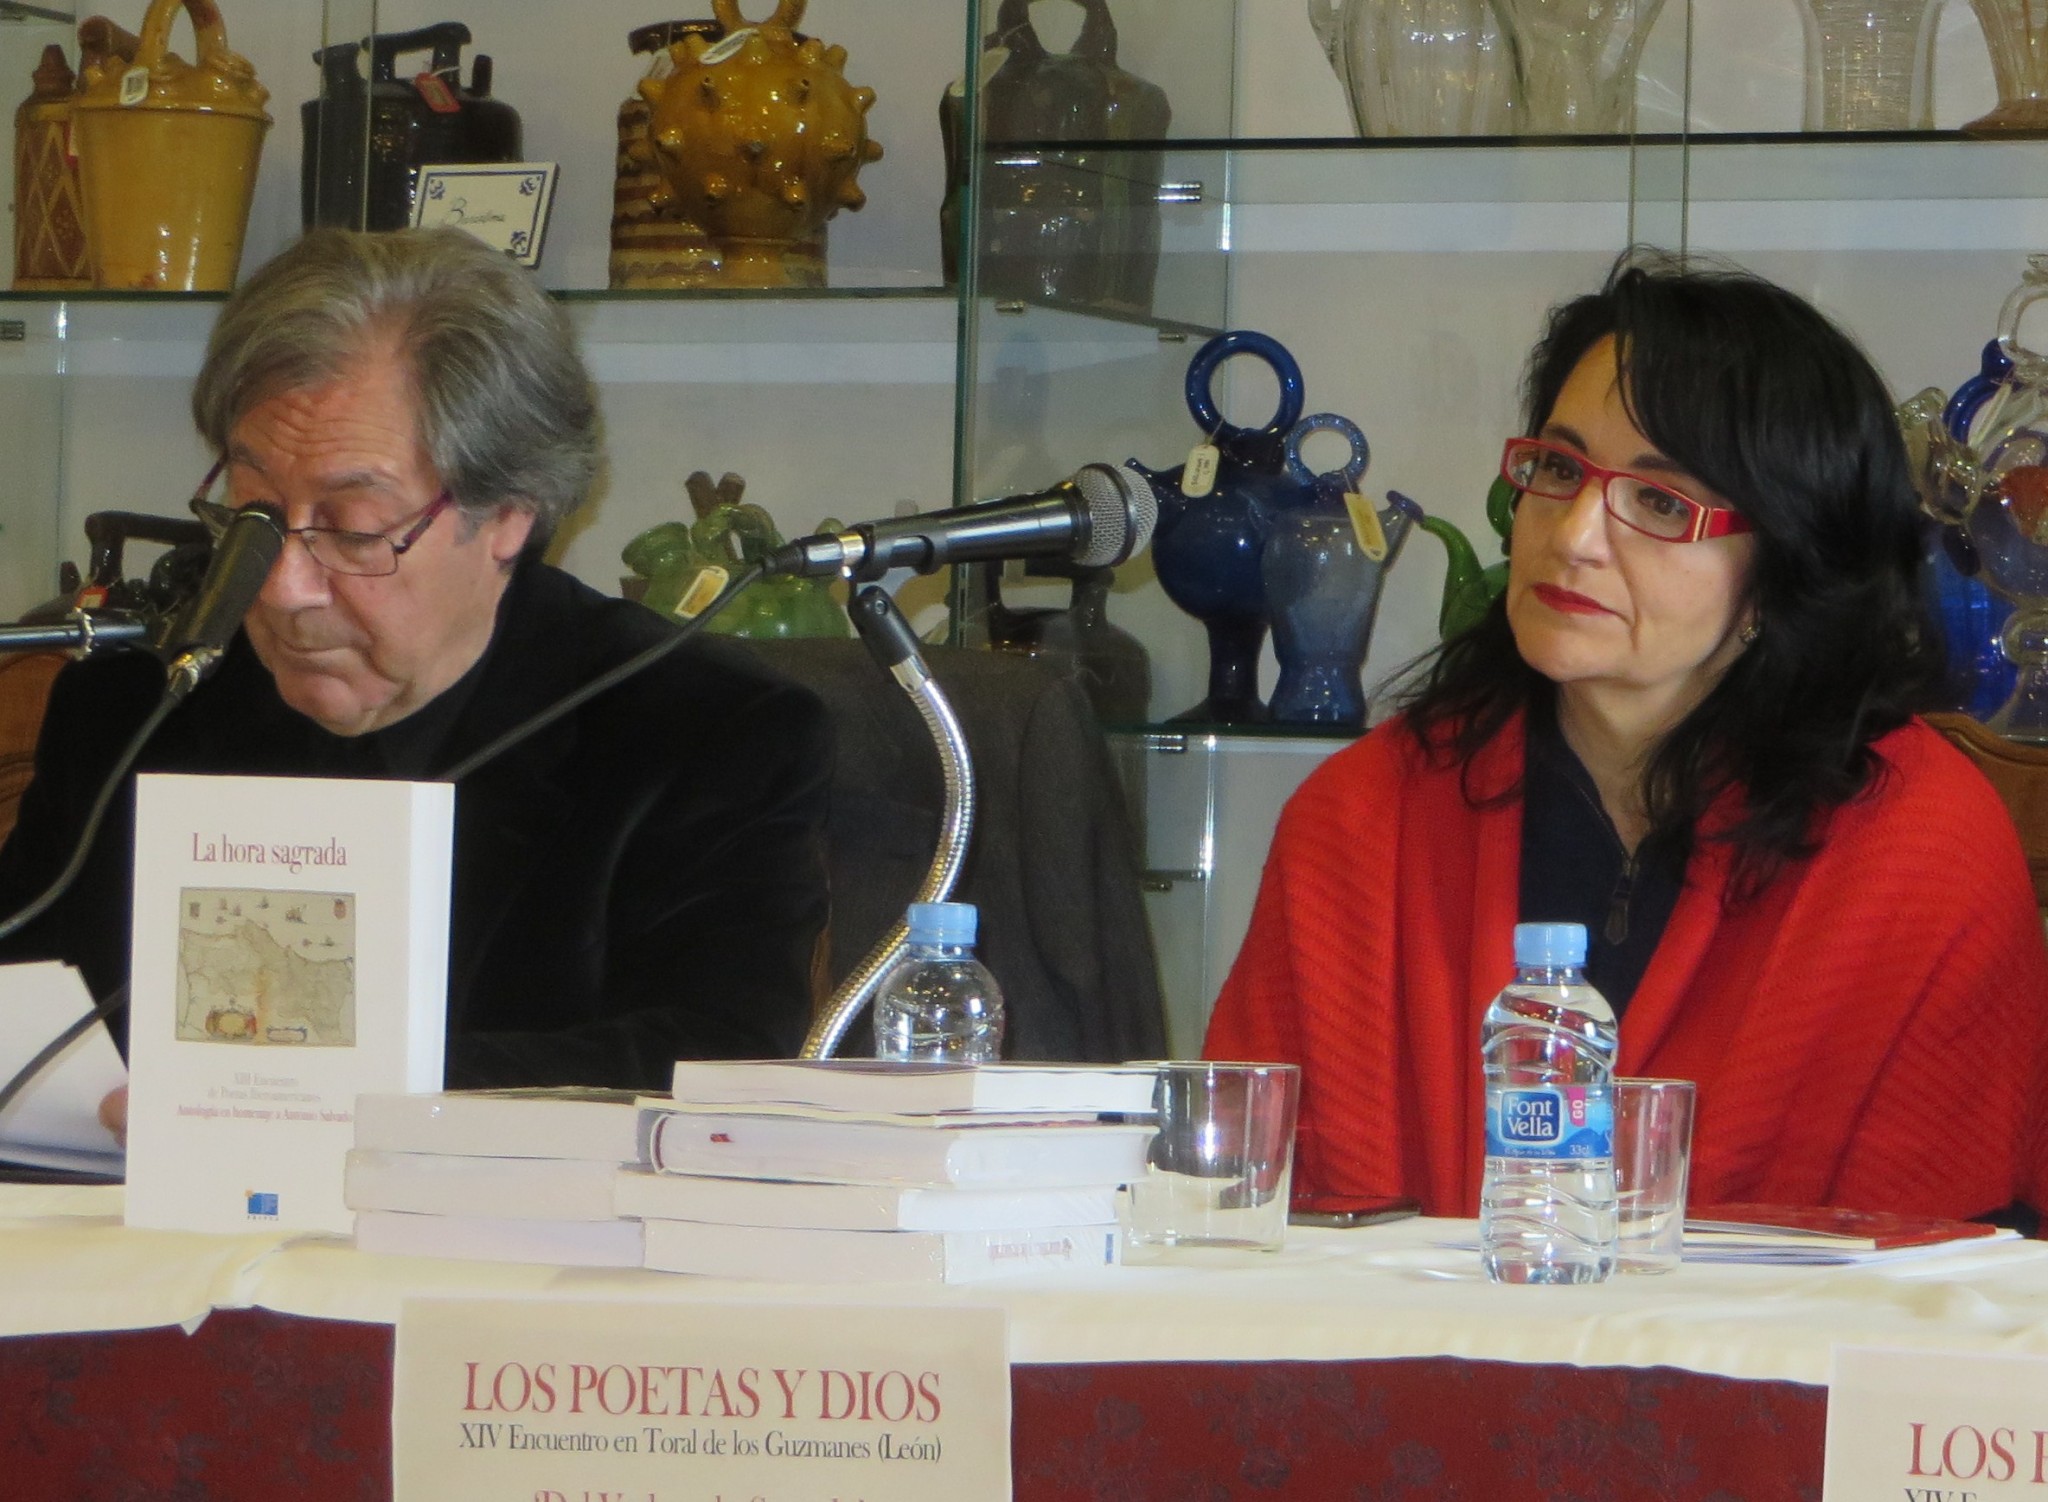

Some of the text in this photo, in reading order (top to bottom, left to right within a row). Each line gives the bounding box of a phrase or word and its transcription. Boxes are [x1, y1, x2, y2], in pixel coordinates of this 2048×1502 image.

[192, 832, 347, 874] La hora sagrada
[1507, 1095, 1554, 1117] Font
[1507, 1116, 1555, 1137] Vella
[1571, 1099, 1584, 1119] GO
[461, 1361, 942, 1423] LOS POETAS Y DIOS
[459, 1422, 942, 1464] XIV Encuentro en Toral de los Guzmanes (León)
[1906, 1422, 2016, 1482] LOS
